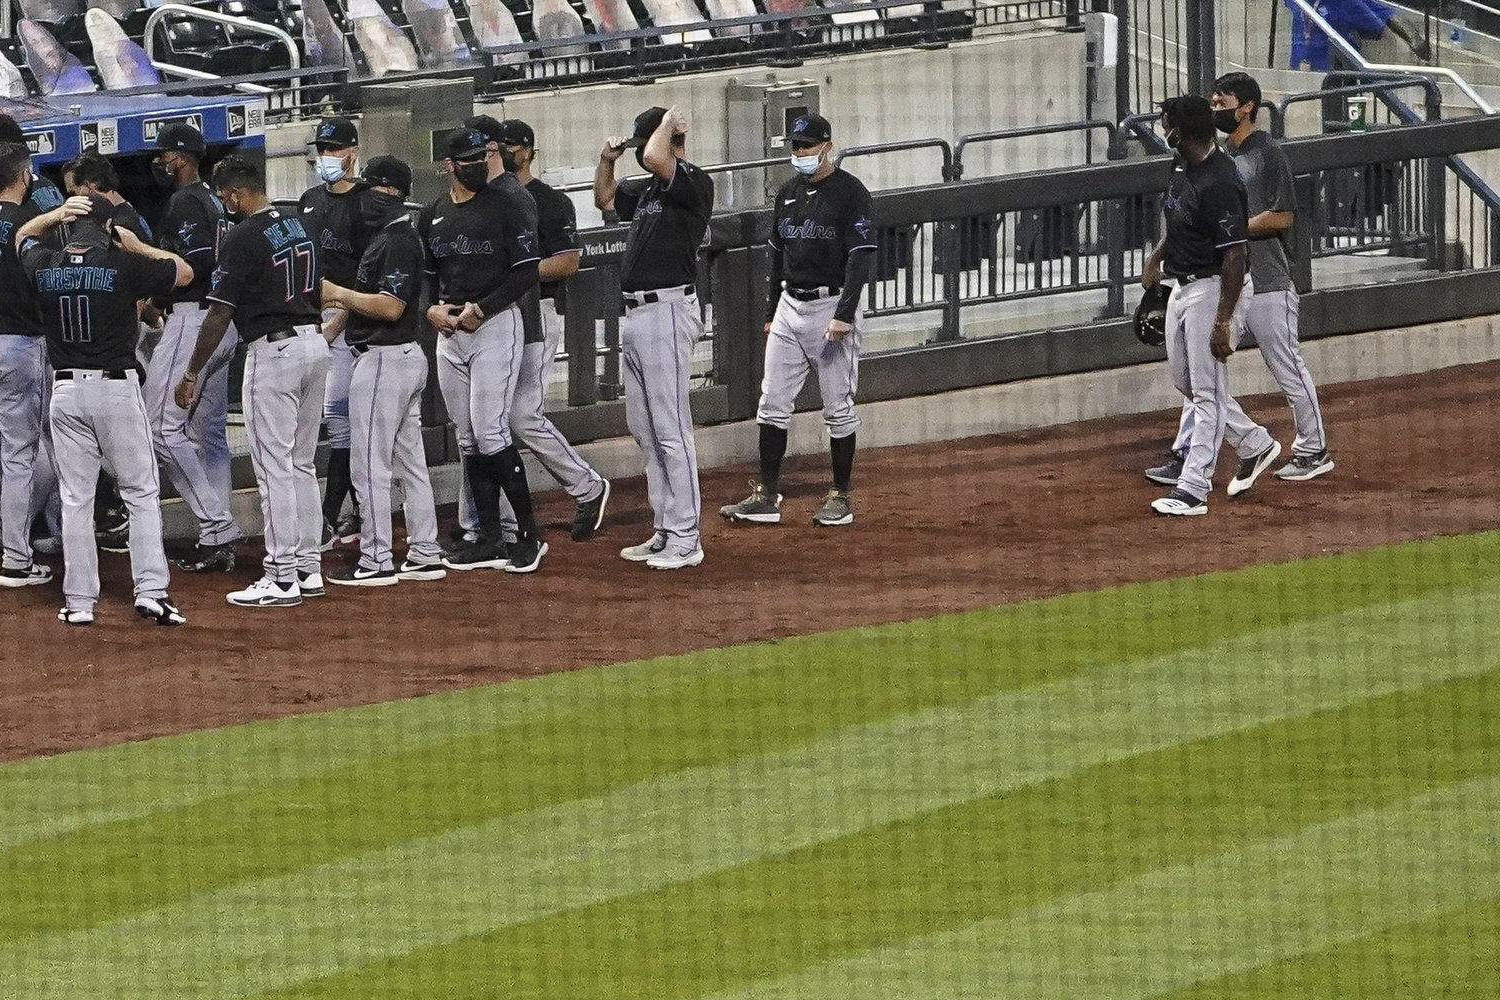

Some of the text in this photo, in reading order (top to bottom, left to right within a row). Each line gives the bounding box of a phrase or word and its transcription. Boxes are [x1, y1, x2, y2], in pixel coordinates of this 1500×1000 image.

[100, 124, 114, 136] NEW
[585, 244, 605, 256] York
[606, 241, 626, 254] Lotte
[35, 266, 118, 292] FORSYTHE
[272, 241, 316, 300] 77
[59, 295, 92, 342] 11
